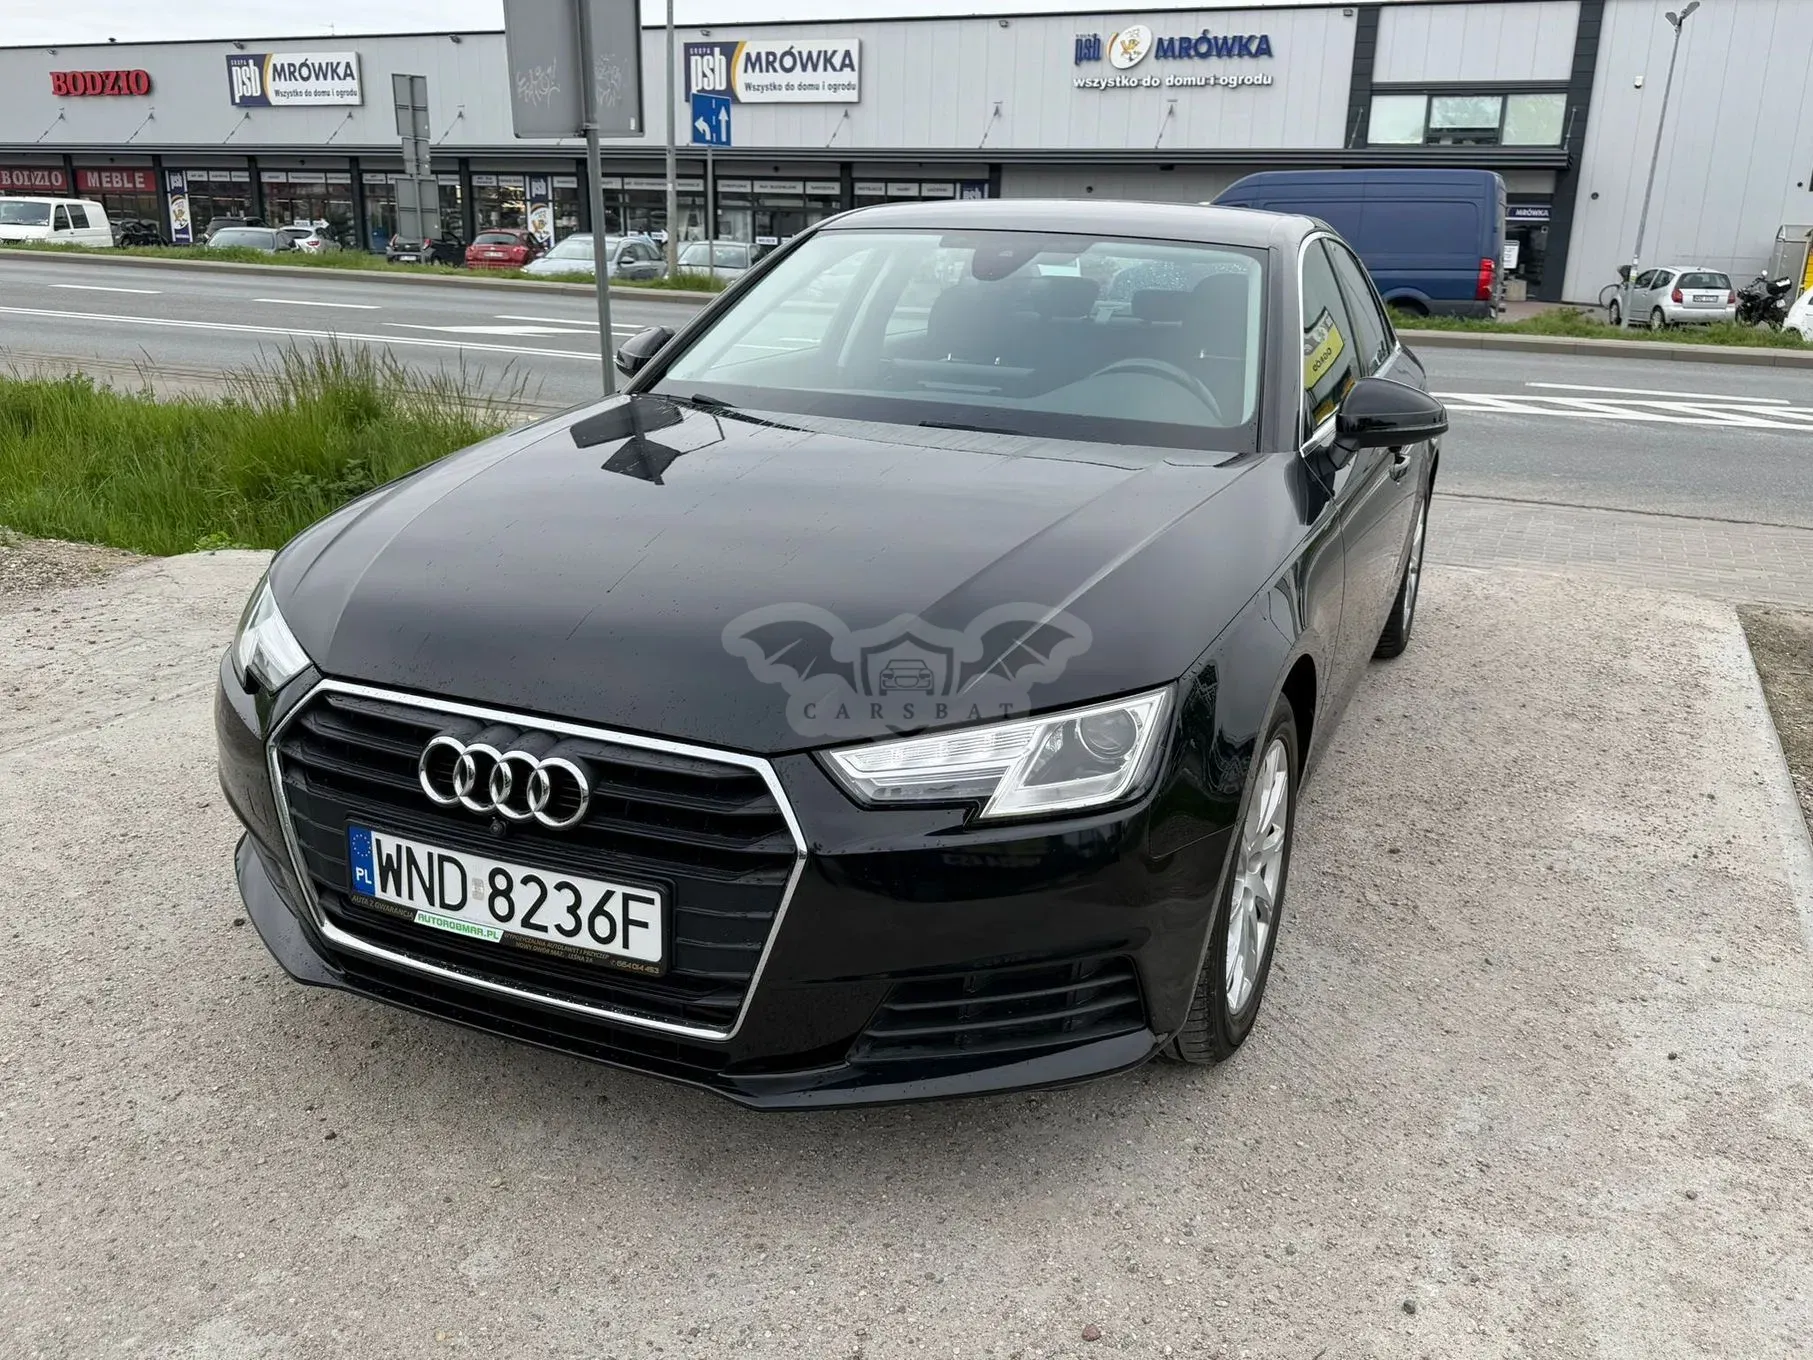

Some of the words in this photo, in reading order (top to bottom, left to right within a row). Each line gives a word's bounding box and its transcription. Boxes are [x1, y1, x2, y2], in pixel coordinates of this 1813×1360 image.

[1155, 29, 1273, 60] MRÓWKA
[272, 58, 356, 82] MRÓWKA
[690, 47, 727, 94] psb
[743, 45, 856, 74] MRÓWKA
[50, 69, 152, 97] BODZIO
[232, 59, 261, 104] psb
[274, 88, 303, 99] Wszystko
[304, 88, 313, 97] do
[314, 88, 331, 97] domu
[336, 88, 358, 99] ogrodu
[744, 82, 783, 94] Wszystko
[785, 82, 796, 92] do
[797, 82, 820, 91] domu
[827, 81, 857, 93] ogrodu
[1073, 76, 1138, 91] wszystko
[1143, 75, 1161, 88] do
[1166, 74, 1206, 87] domu
[1209, 74, 1215, 86] i
[1219, 73, 1273, 90] ogrodu
[1, 170, 63, 187] BODZIO
[87, 172, 145, 188] MEBLE
[355, 866, 373, 885] PL
[375, 838, 468, 912] WND
[487, 867, 655, 950] 8236F
[417, 912, 500, 940] AUTOROBMAR.PL
